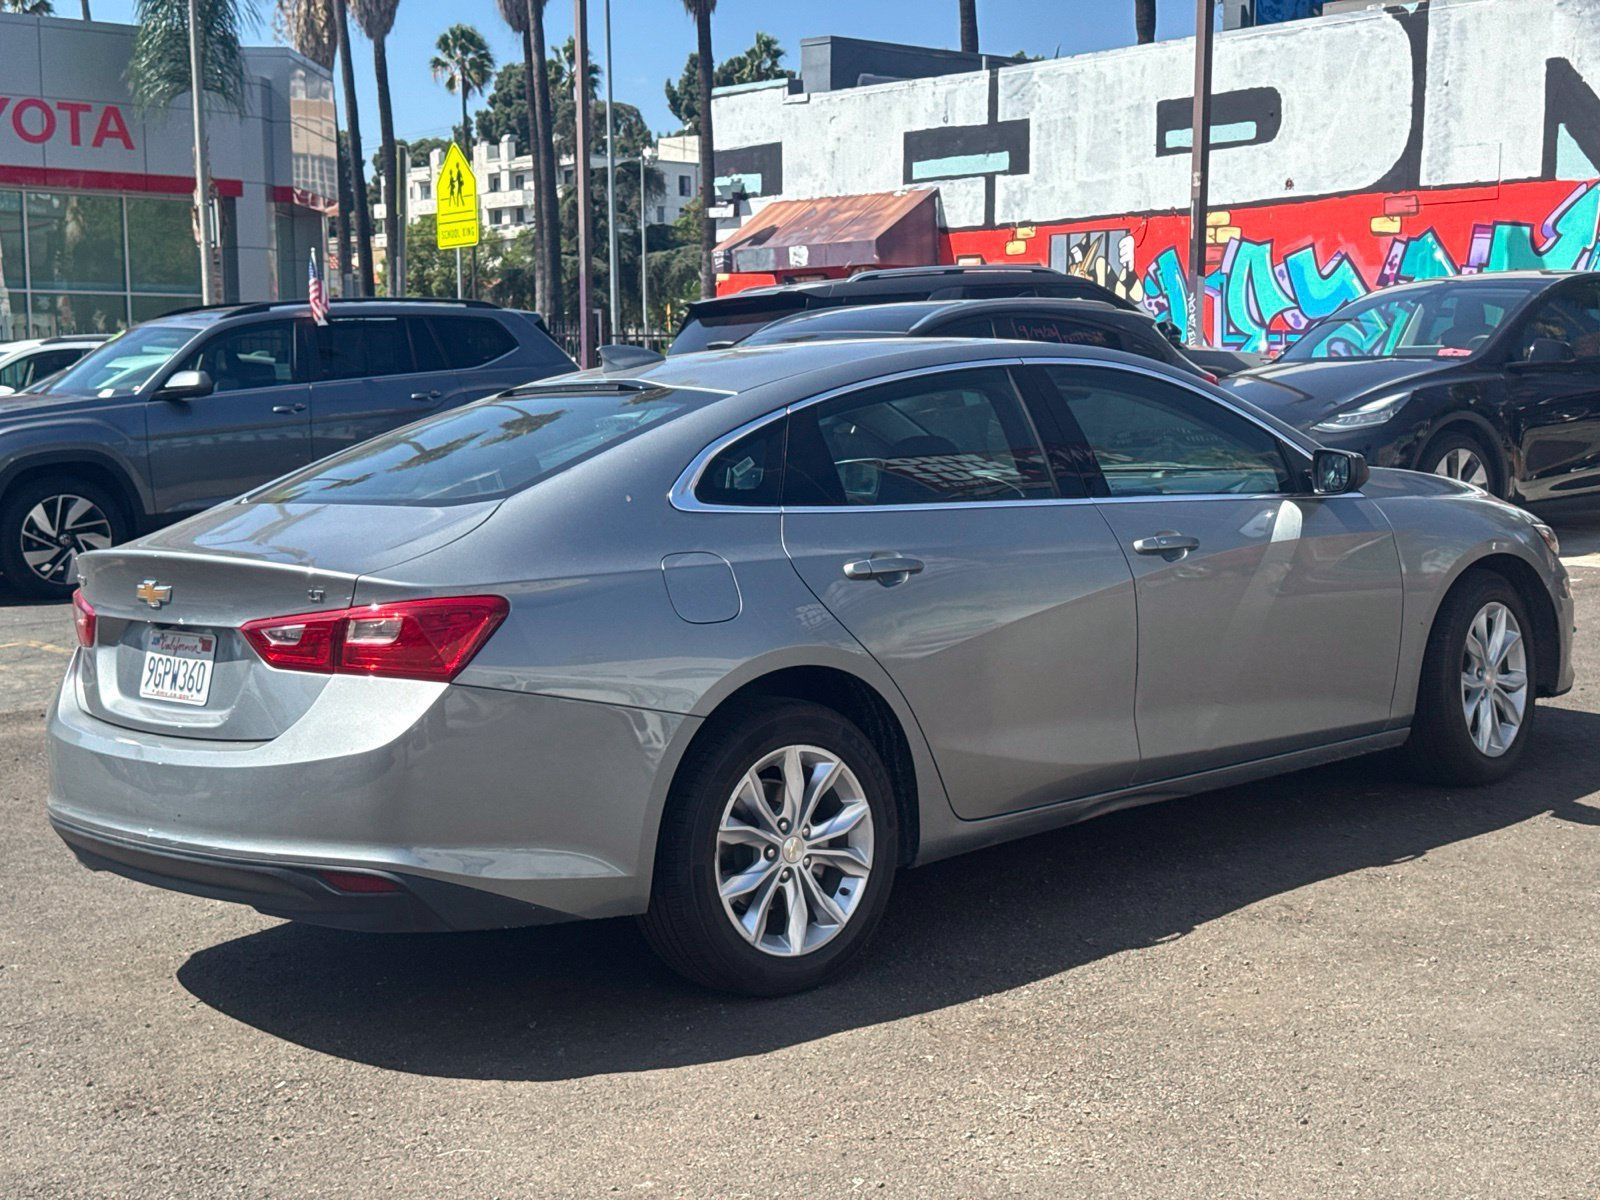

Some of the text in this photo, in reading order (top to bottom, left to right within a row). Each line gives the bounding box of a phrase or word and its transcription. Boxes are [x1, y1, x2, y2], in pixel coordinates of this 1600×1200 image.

[441, 227, 475, 240] SCHOOL XING
[145, 656, 206, 693] 9GPW360
